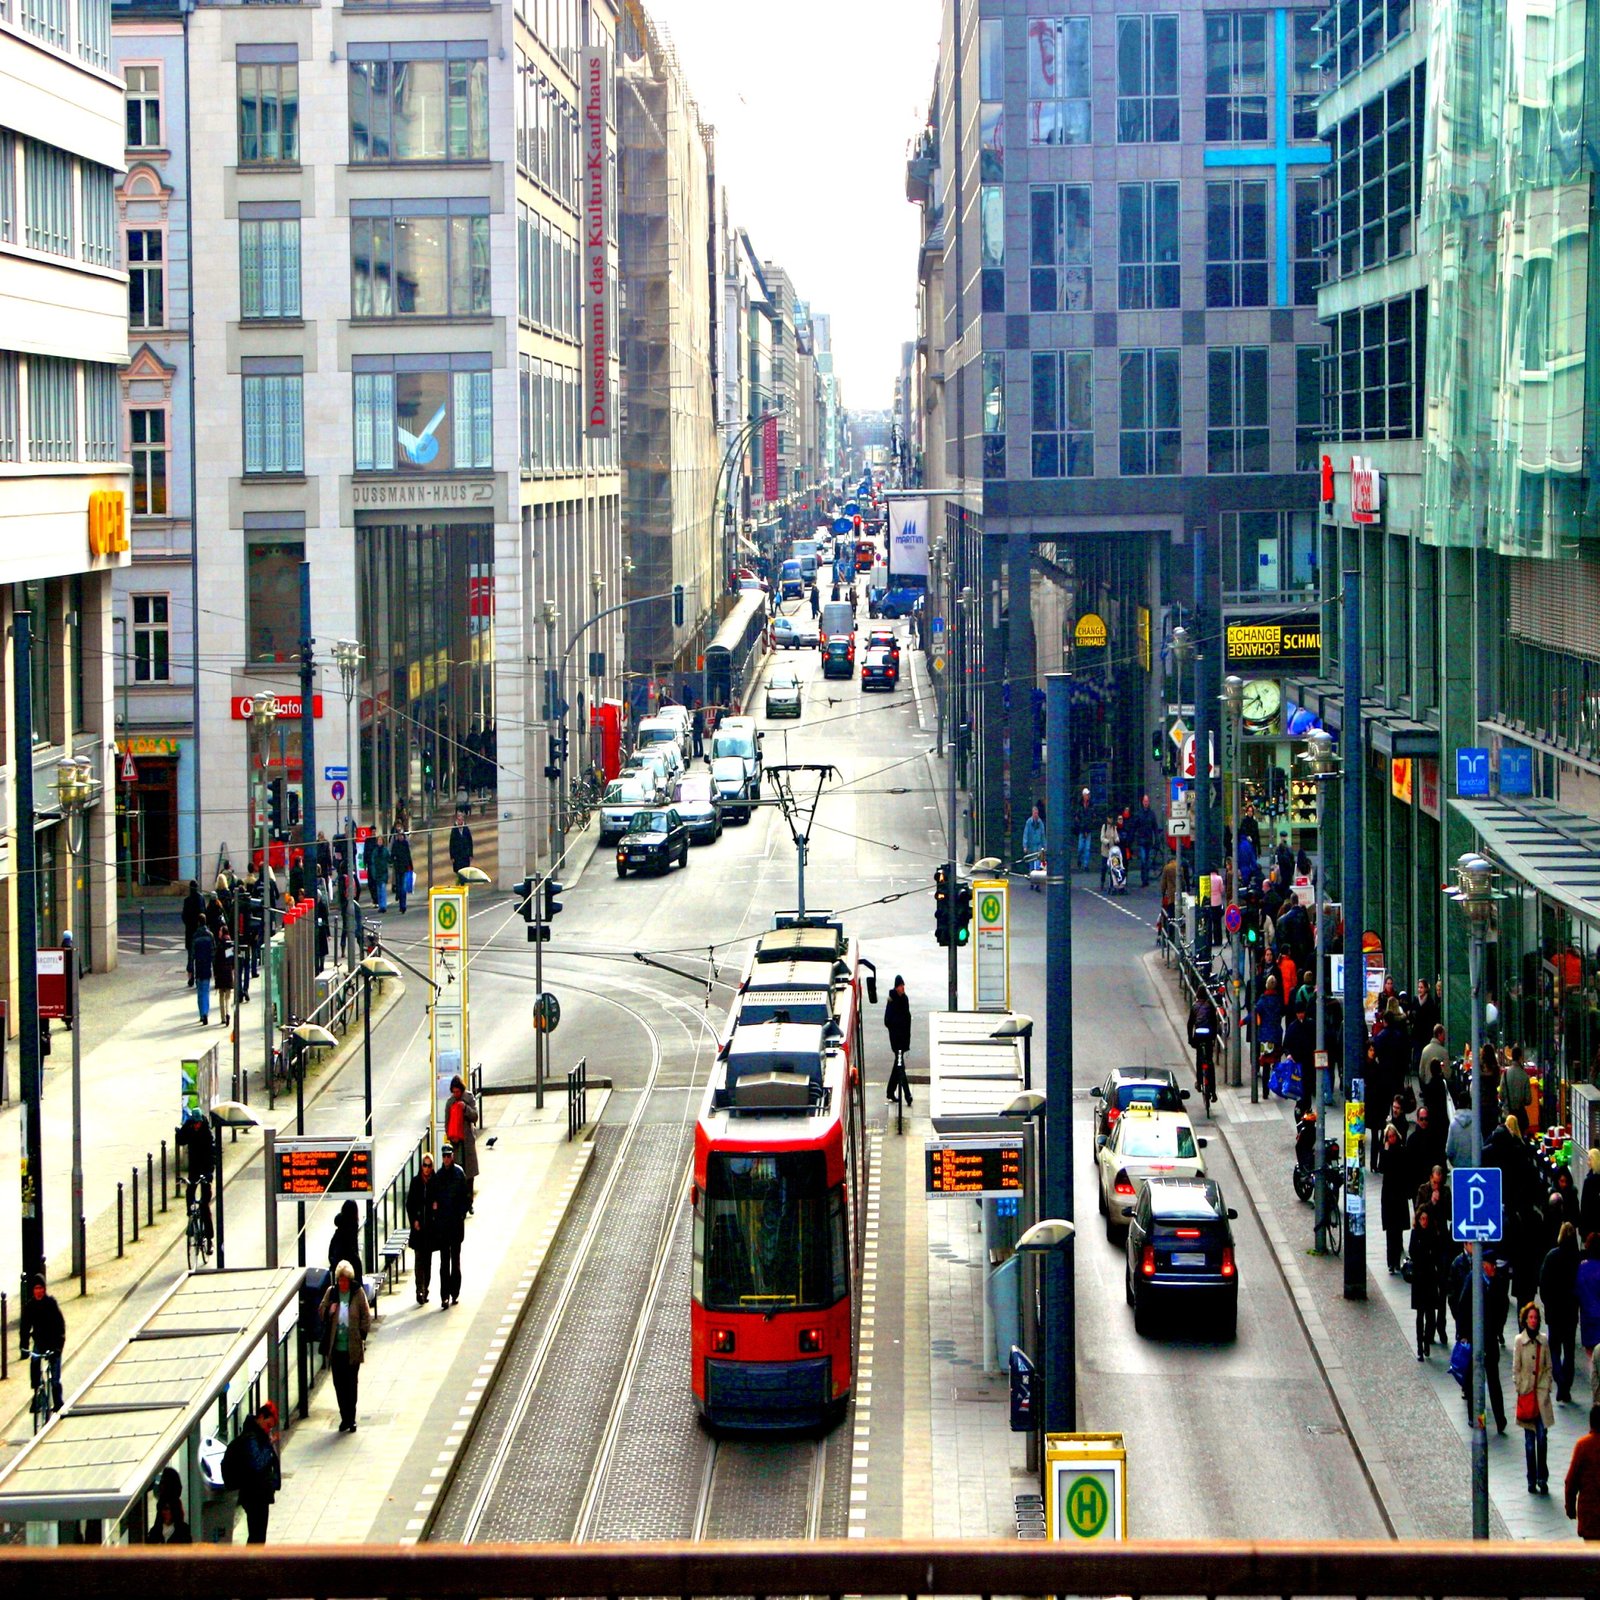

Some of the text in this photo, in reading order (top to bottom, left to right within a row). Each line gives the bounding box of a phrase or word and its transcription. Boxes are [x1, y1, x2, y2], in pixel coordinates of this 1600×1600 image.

[587, 57, 606, 427] Dussmann das KulturKaufhaus
[353, 485, 467, 503] DUSSMANN-HAUS
[89, 490, 129, 556] OPEL
[1078, 627, 1104, 635] CHANGE
[1076, 637, 1106, 646] LEIHHAUS
[353, 1153, 357, 1161] 2
[933, 1153, 941, 1161] M1
[1002, 1151, 1008, 1159] 11
[351, 1167, 357, 1175] 12
[934, 1166, 941, 1174] 12
[284, 1181, 291, 1190] 12
[351, 1180, 358, 1188] 17
[933, 1180, 941, 1188] M1
[1470, 1186, 1484, 1222] P
